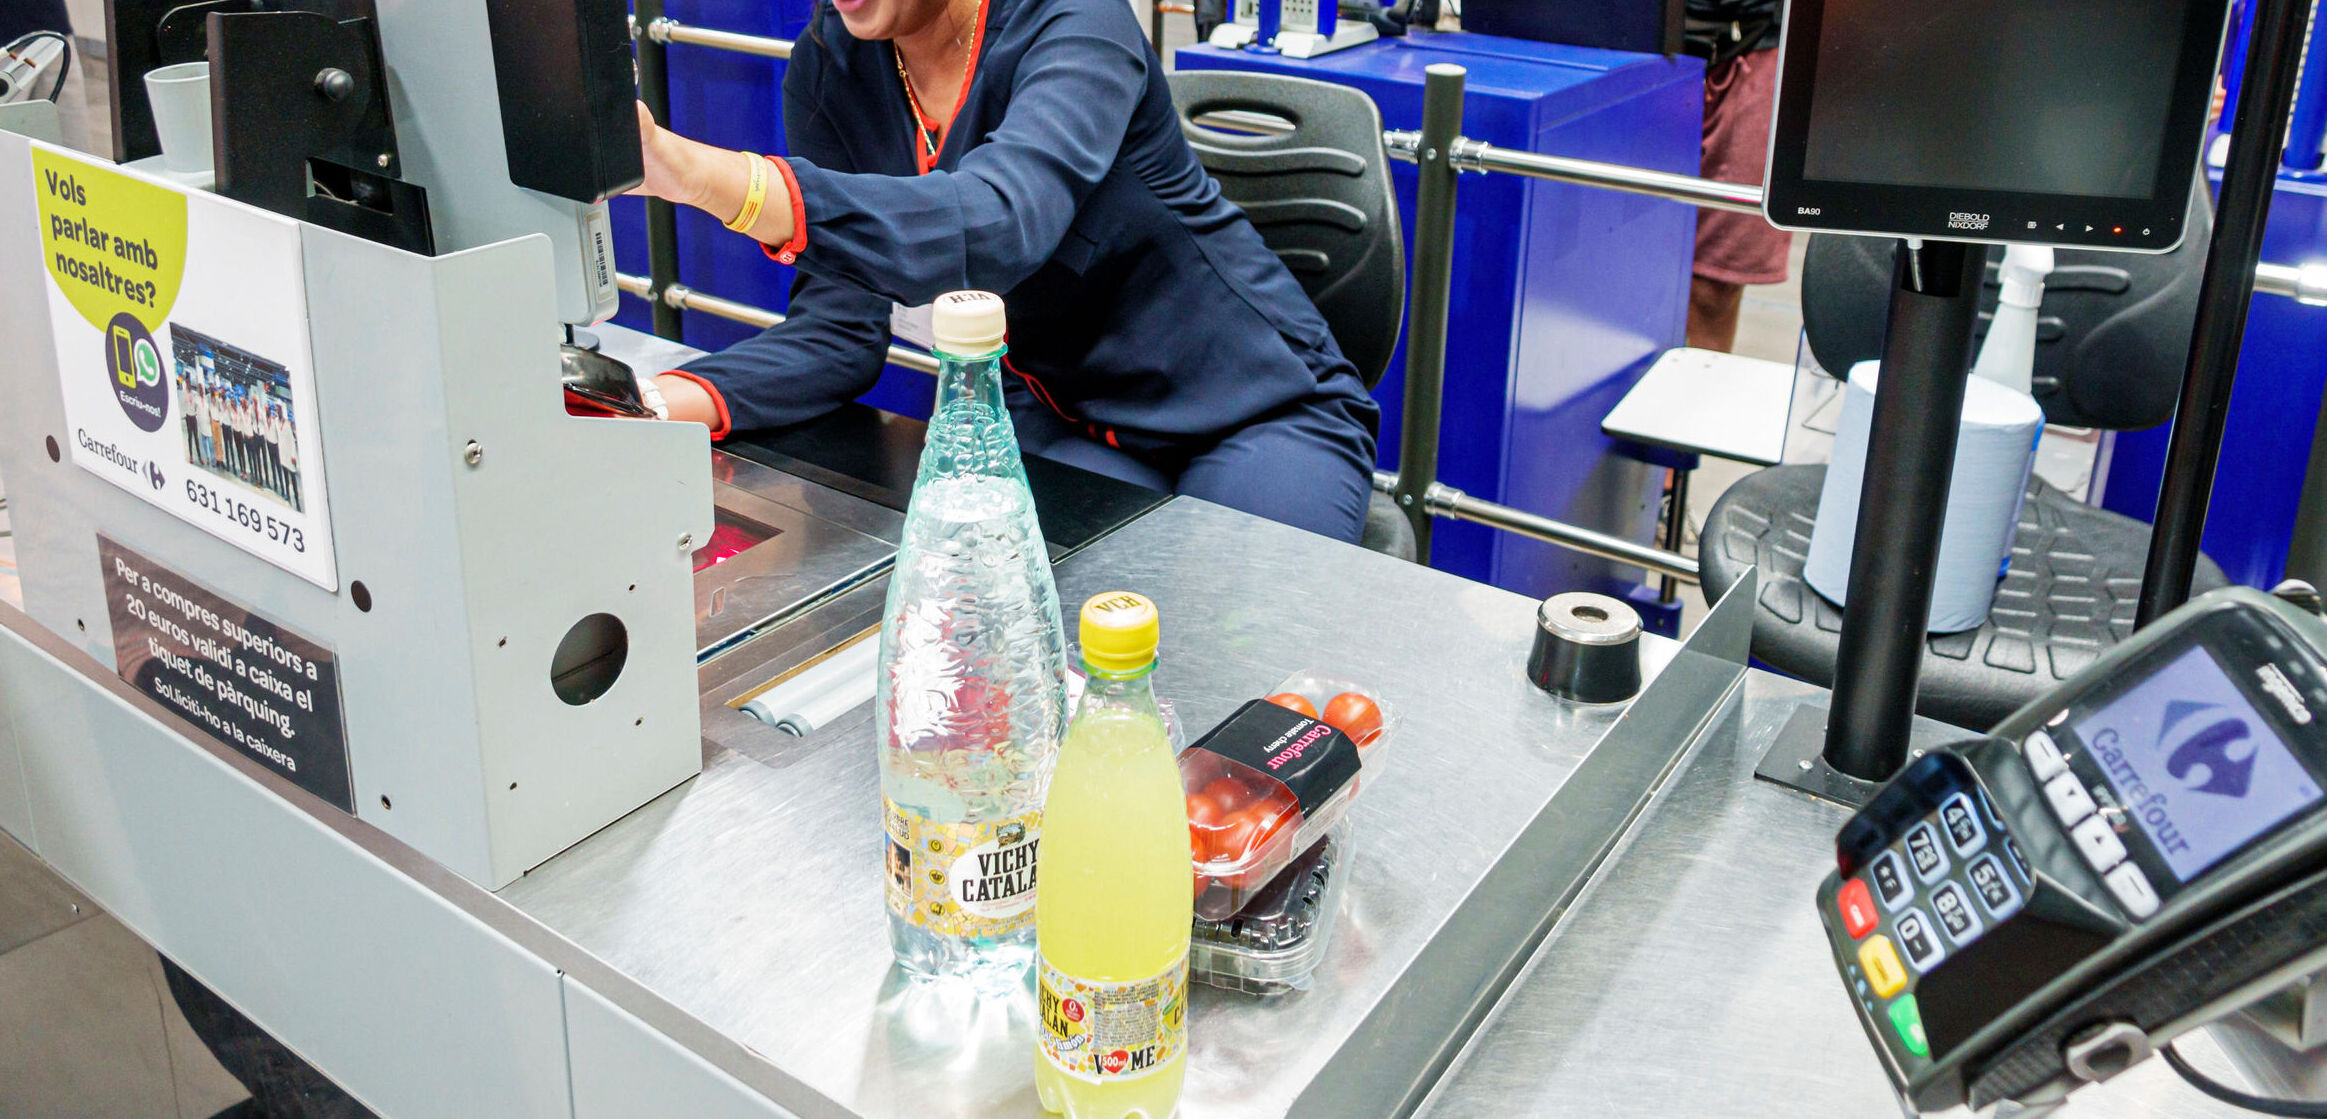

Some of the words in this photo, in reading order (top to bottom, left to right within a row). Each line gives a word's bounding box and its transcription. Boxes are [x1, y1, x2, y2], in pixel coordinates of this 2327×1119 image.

[45, 168, 86, 206] Vols
[1797, 206, 1821, 216] BA90
[1947, 220, 1989, 231] NIXDORF
[1949, 211, 1990, 222] DIEBOLD
[51, 212, 109, 253] parlar
[113, 236, 158, 271] amb
[56, 250, 157, 308] nosaltres?
[120, 390, 162, 418] Escriu-nos!
[78, 427, 139, 475] Carrefour
[186, 478, 221, 514] 631
[226, 497, 262, 533] 169
[267, 516, 305, 554] 573
[116, 557, 139, 587] Per
[142, 578, 151, 594] a
[153, 581, 219, 631] compres
[222, 618, 302, 673] superiors
[306, 662, 318, 681] a
[126, 593, 146, 621] 20
[149, 610, 190, 646] euros
[192, 633, 233, 671] validi
[235, 657, 247, 677] a
[249, 665, 293, 703] caixa
[296, 689, 314, 713] el
[148, 637, 193, 678] tiquet
[194, 663, 215, 692] de
[217, 679, 296, 738] pàrquing.
[223, 722, 230, 736] a
[232, 722, 245, 744] la
[247, 733, 297, 772] caixera
[1263, 735, 1288, 754] cherry
[1266, 724, 1332, 770] Carrefour
[1284, 718, 1315, 738] Tomate
[2092, 727, 2190, 855] Carrefour
[1947, 807, 1966, 824] 4
[977, 838, 1040, 877] VICHY
[1910, 831, 1929, 849] 7
[962, 864, 1037, 902] CATALA
[1974, 863, 1992, 881] 5
[1936, 895, 1957, 913] 8
[1131, 1046, 1155, 1072] ME
